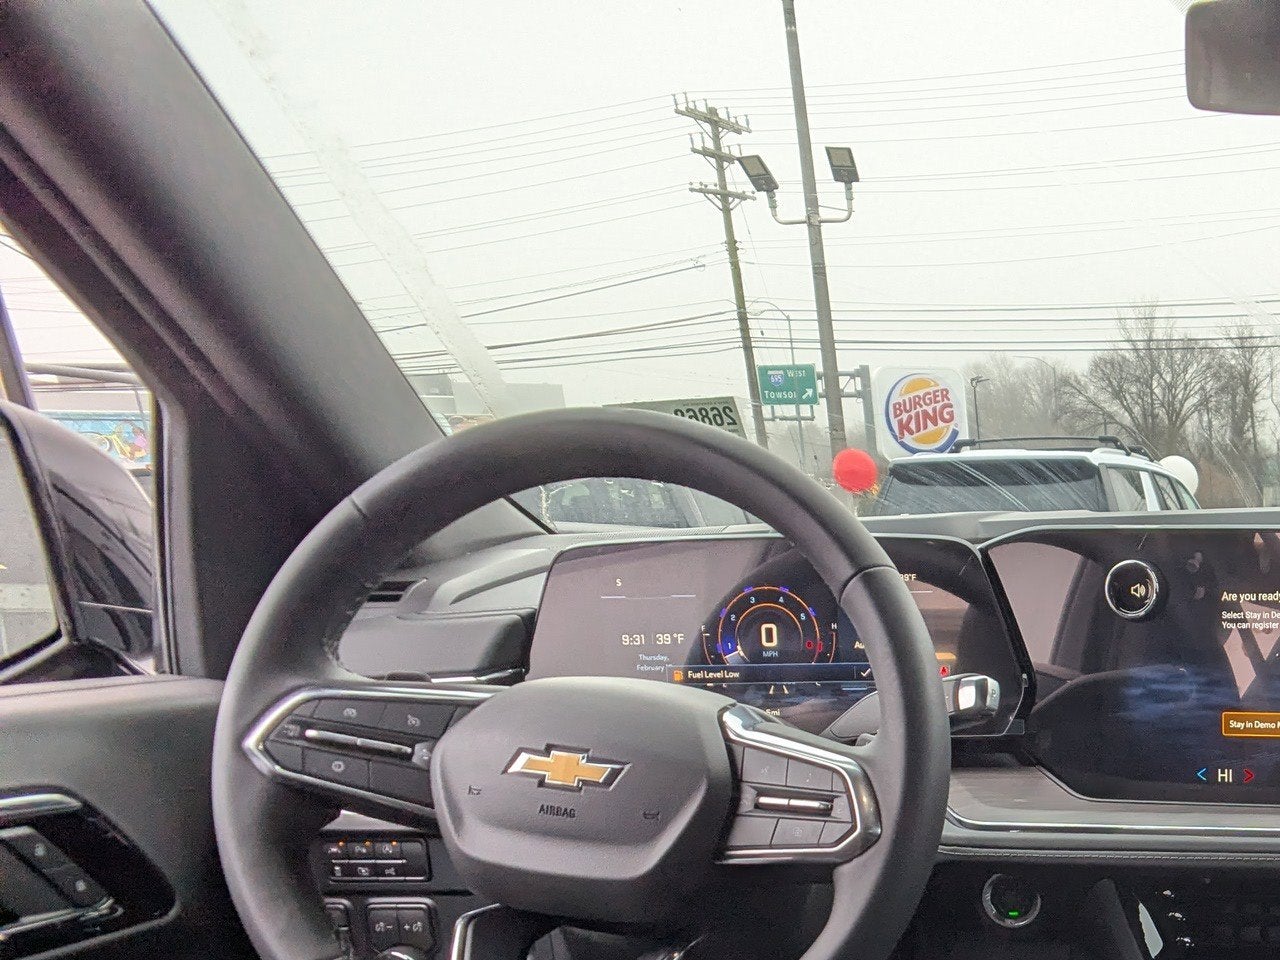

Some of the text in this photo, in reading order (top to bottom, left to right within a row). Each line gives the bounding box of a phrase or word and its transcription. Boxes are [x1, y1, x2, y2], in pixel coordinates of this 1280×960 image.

[770, 374, 782, 383] 695
[892, 387, 951, 419] BURGER
[896, 402, 955, 440] KING
[1221, 592, 1238, 601] Are
[1239, 593, 1257, 603] you
[1221, 611, 1244, 619] Select
[1245, 611, 1261, 621] Stay
[1262, 611, 1270, 619] in
[1222, 621, 1236, 629] You
[1251, 621, 1279, 630] register
[621, 634, 645, 646] 9:31
[760, 623, 778, 648] 0
[636, 664, 665, 672] February
[687, 670, 703, 679] Fuel
[706, 670, 723, 679] Level
[1229, 719, 1246, 730] Stay
[1246, 720, 1253, 729] in
[1254, 720, 1276, 729] Demo
[1217, 768, 1233, 783] HI
[538, 804, 577, 820] AIRBAG
